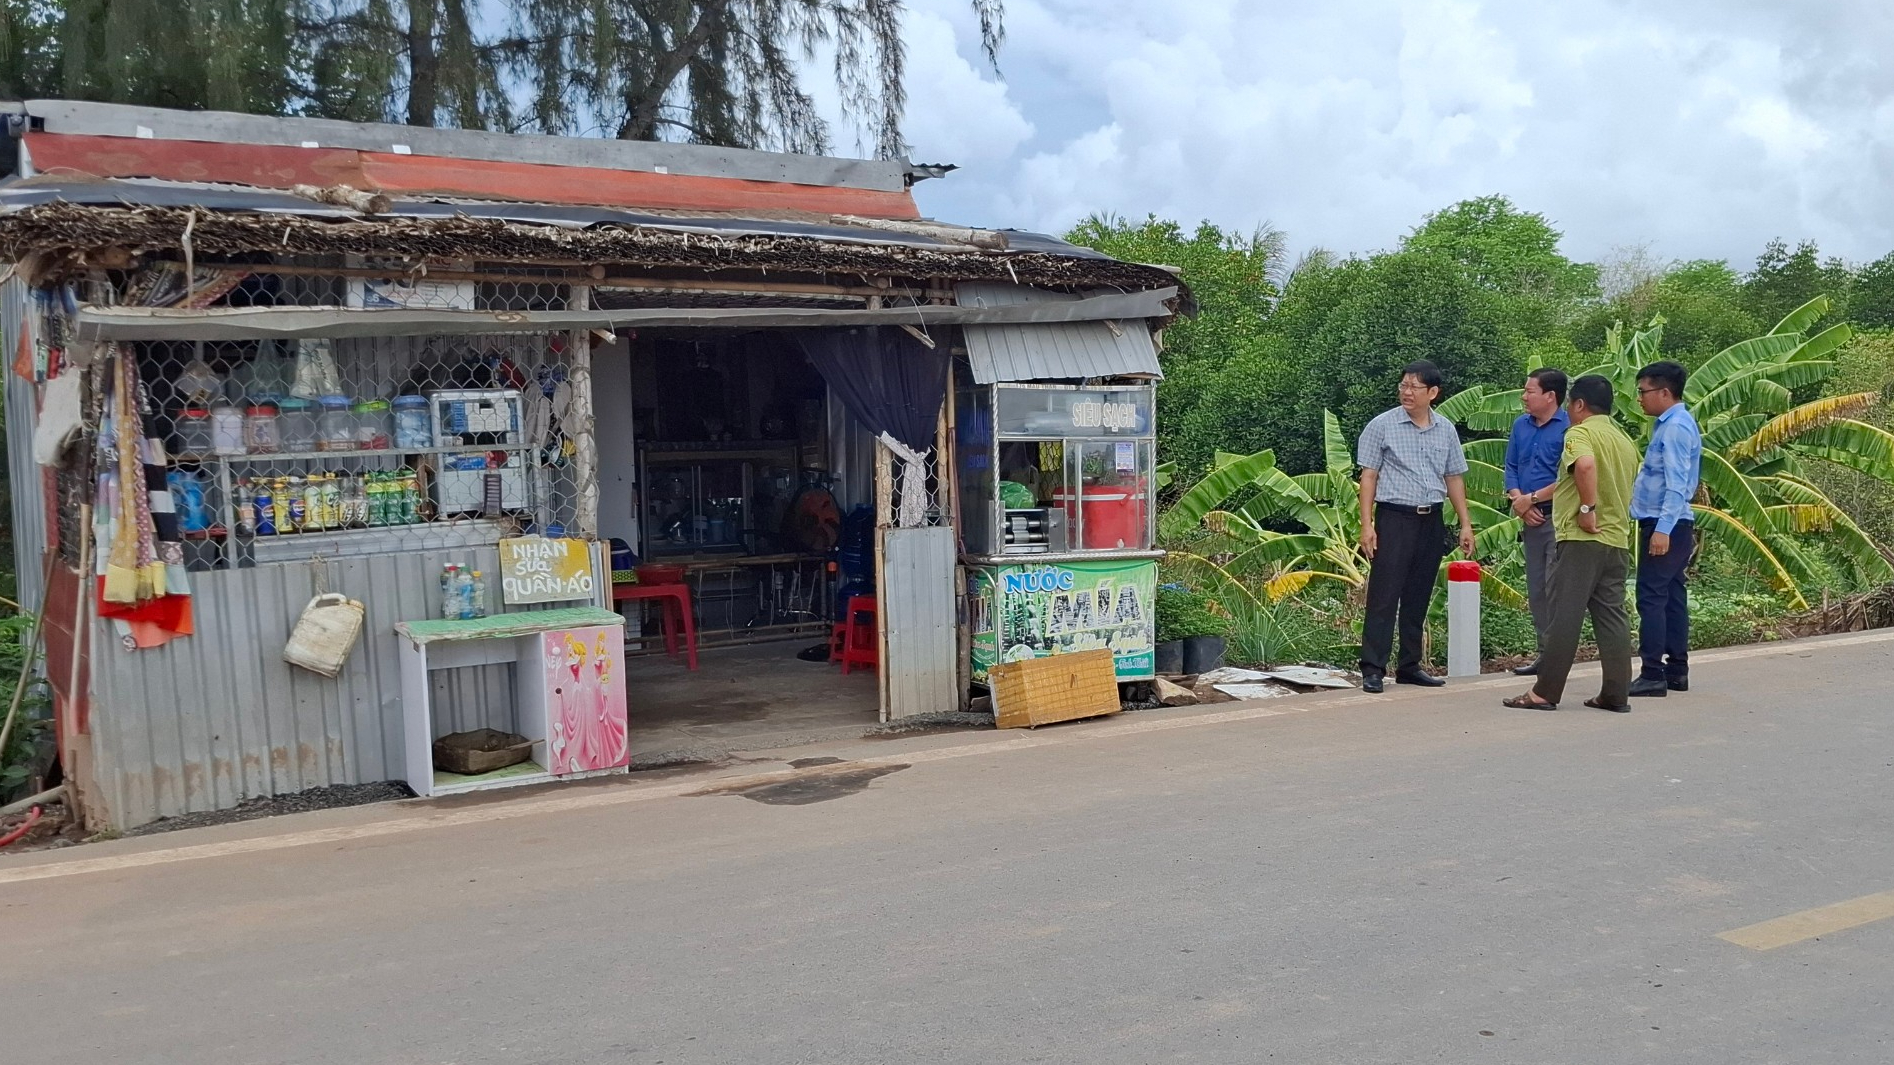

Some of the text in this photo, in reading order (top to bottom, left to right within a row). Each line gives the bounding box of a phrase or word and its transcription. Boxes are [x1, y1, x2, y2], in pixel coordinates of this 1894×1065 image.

[1072, 397, 1136, 431] SIÊU SẠCH
[513, 538, 568, 559] NHẬN
[567, 570, 593, 594] ÁO
[1004, 566, 1074, 594] NƯỚC
[1045, 577, 1147, 637] MÍA
